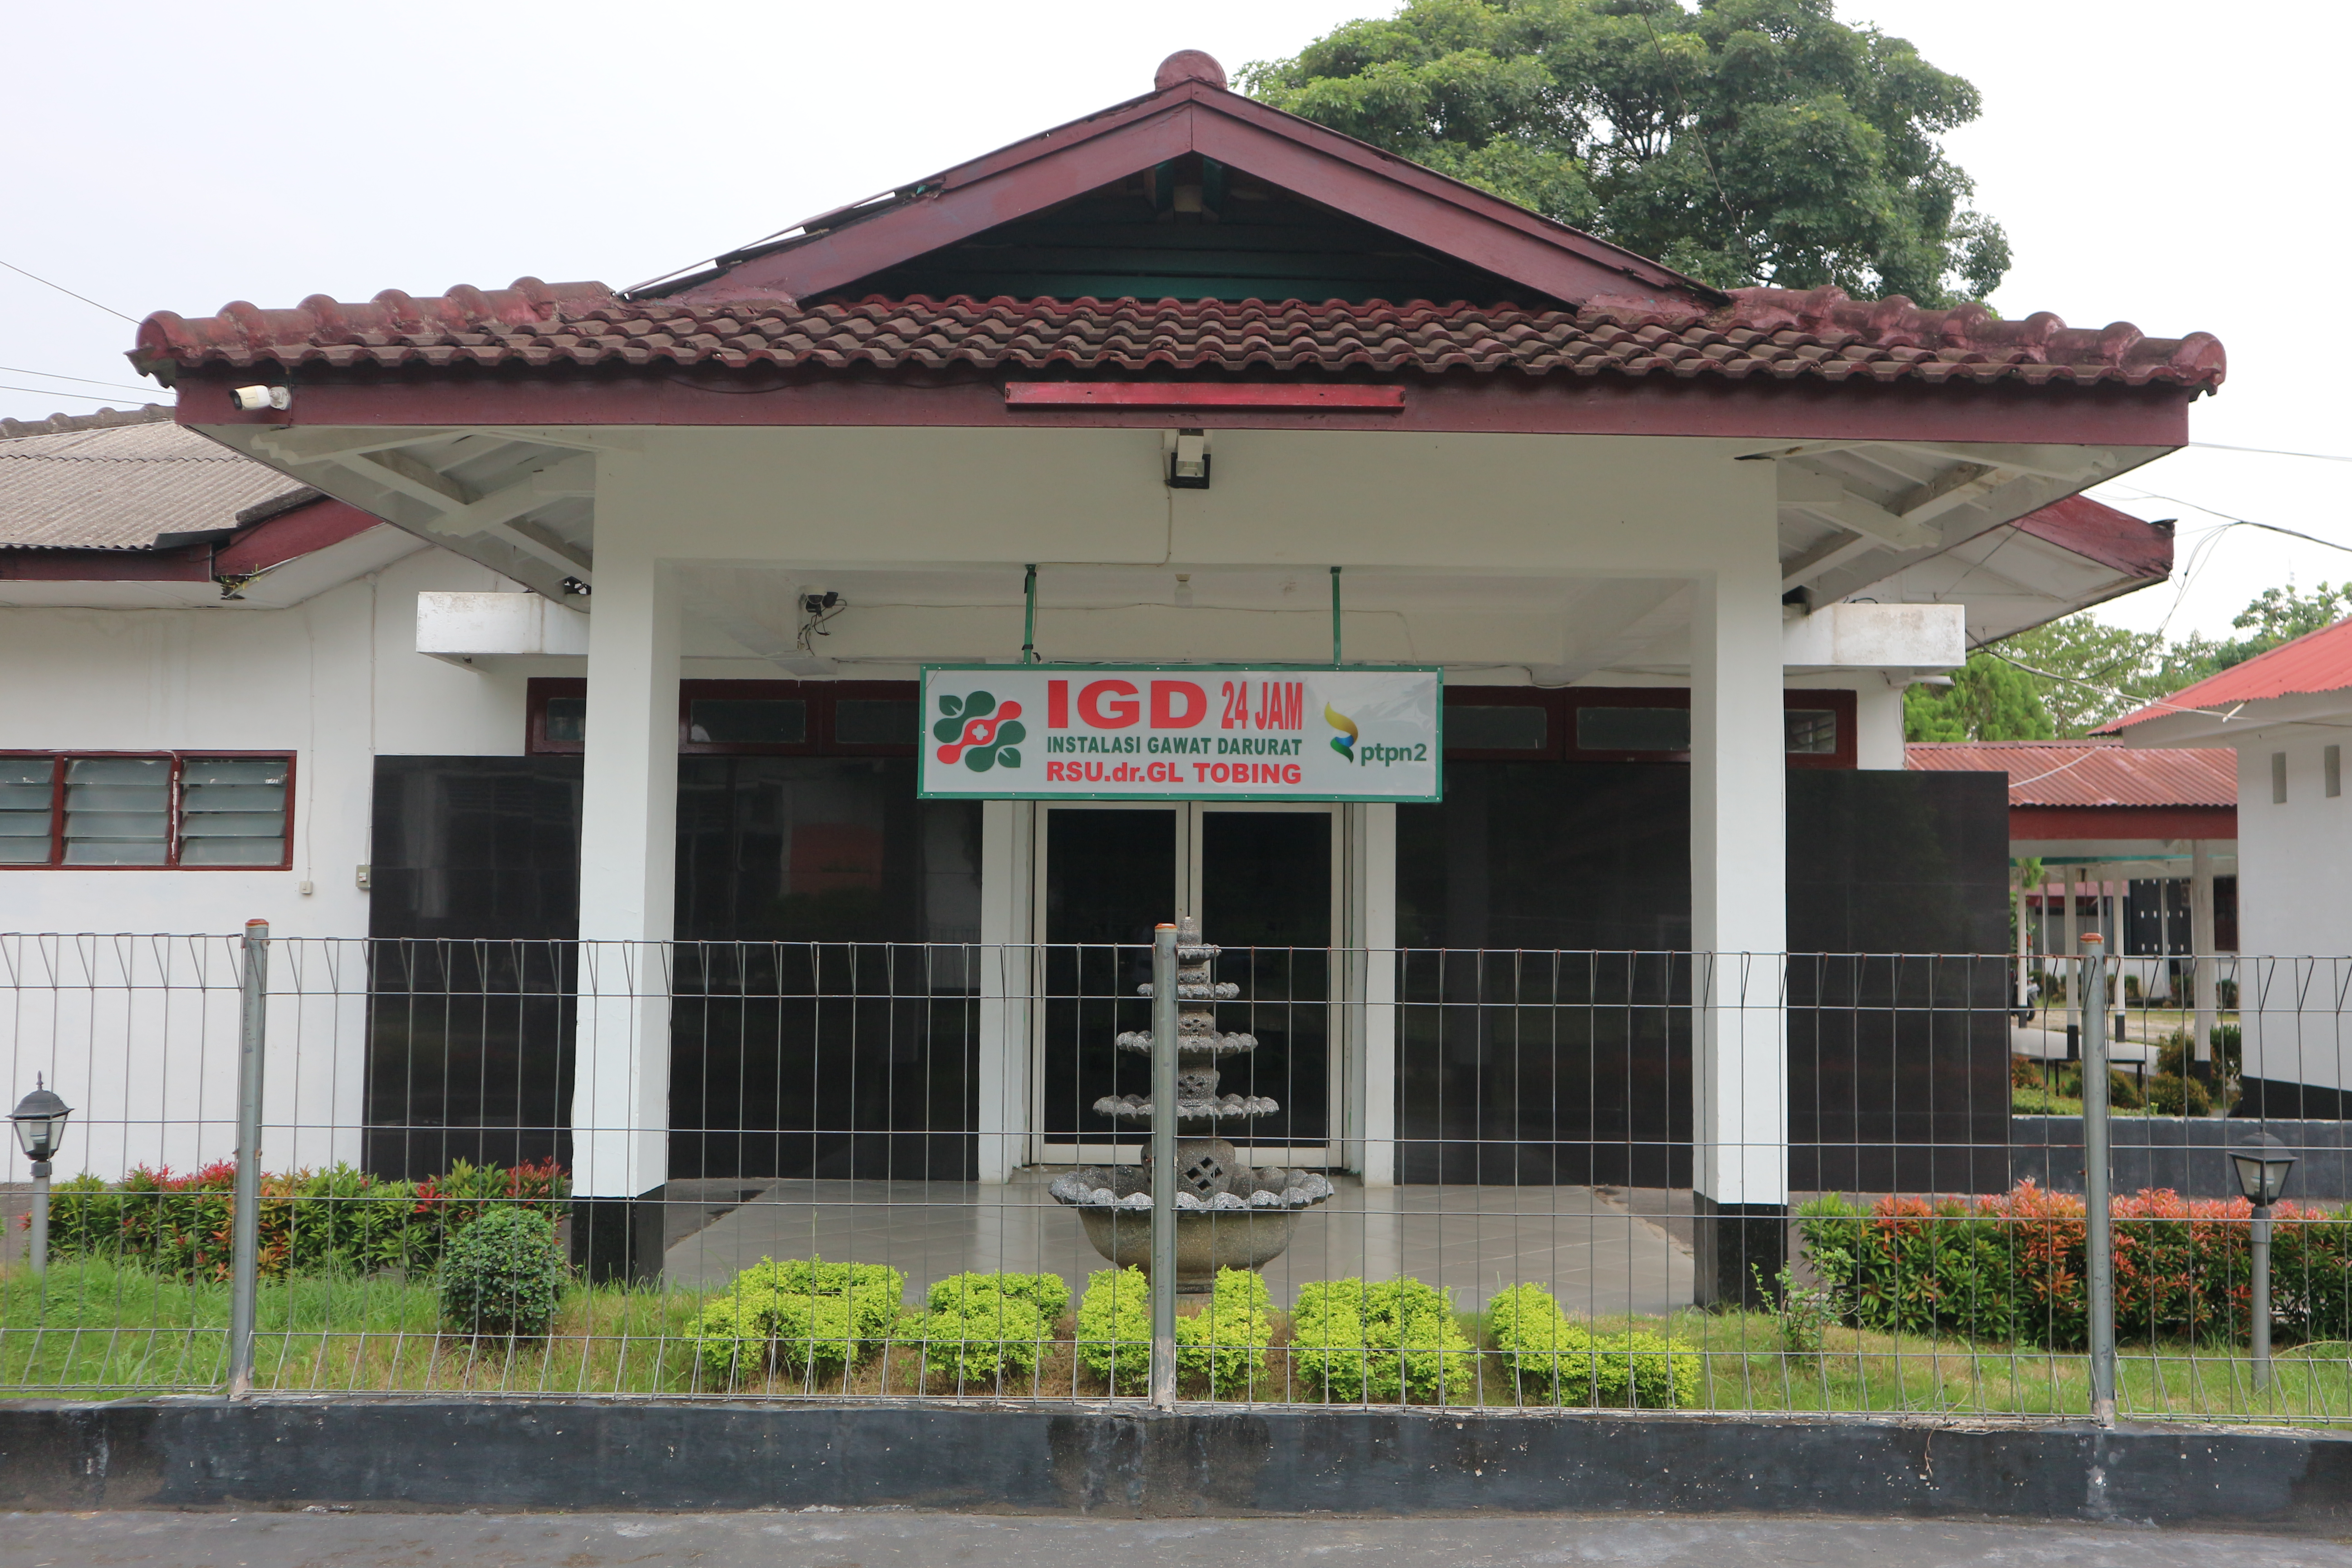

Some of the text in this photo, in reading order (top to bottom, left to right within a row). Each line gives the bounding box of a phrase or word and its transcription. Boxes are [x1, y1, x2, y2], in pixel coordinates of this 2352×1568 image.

[1047, 679, 1303, 730] IGD 24 JAM
[1047, 736, 1303, 756] INSTALASI GAWAT DARURAT
[1361, 743, 1427, 767] ptpn2
[1046, 760, 1302, 784] RSU.dr.GL TOBING
